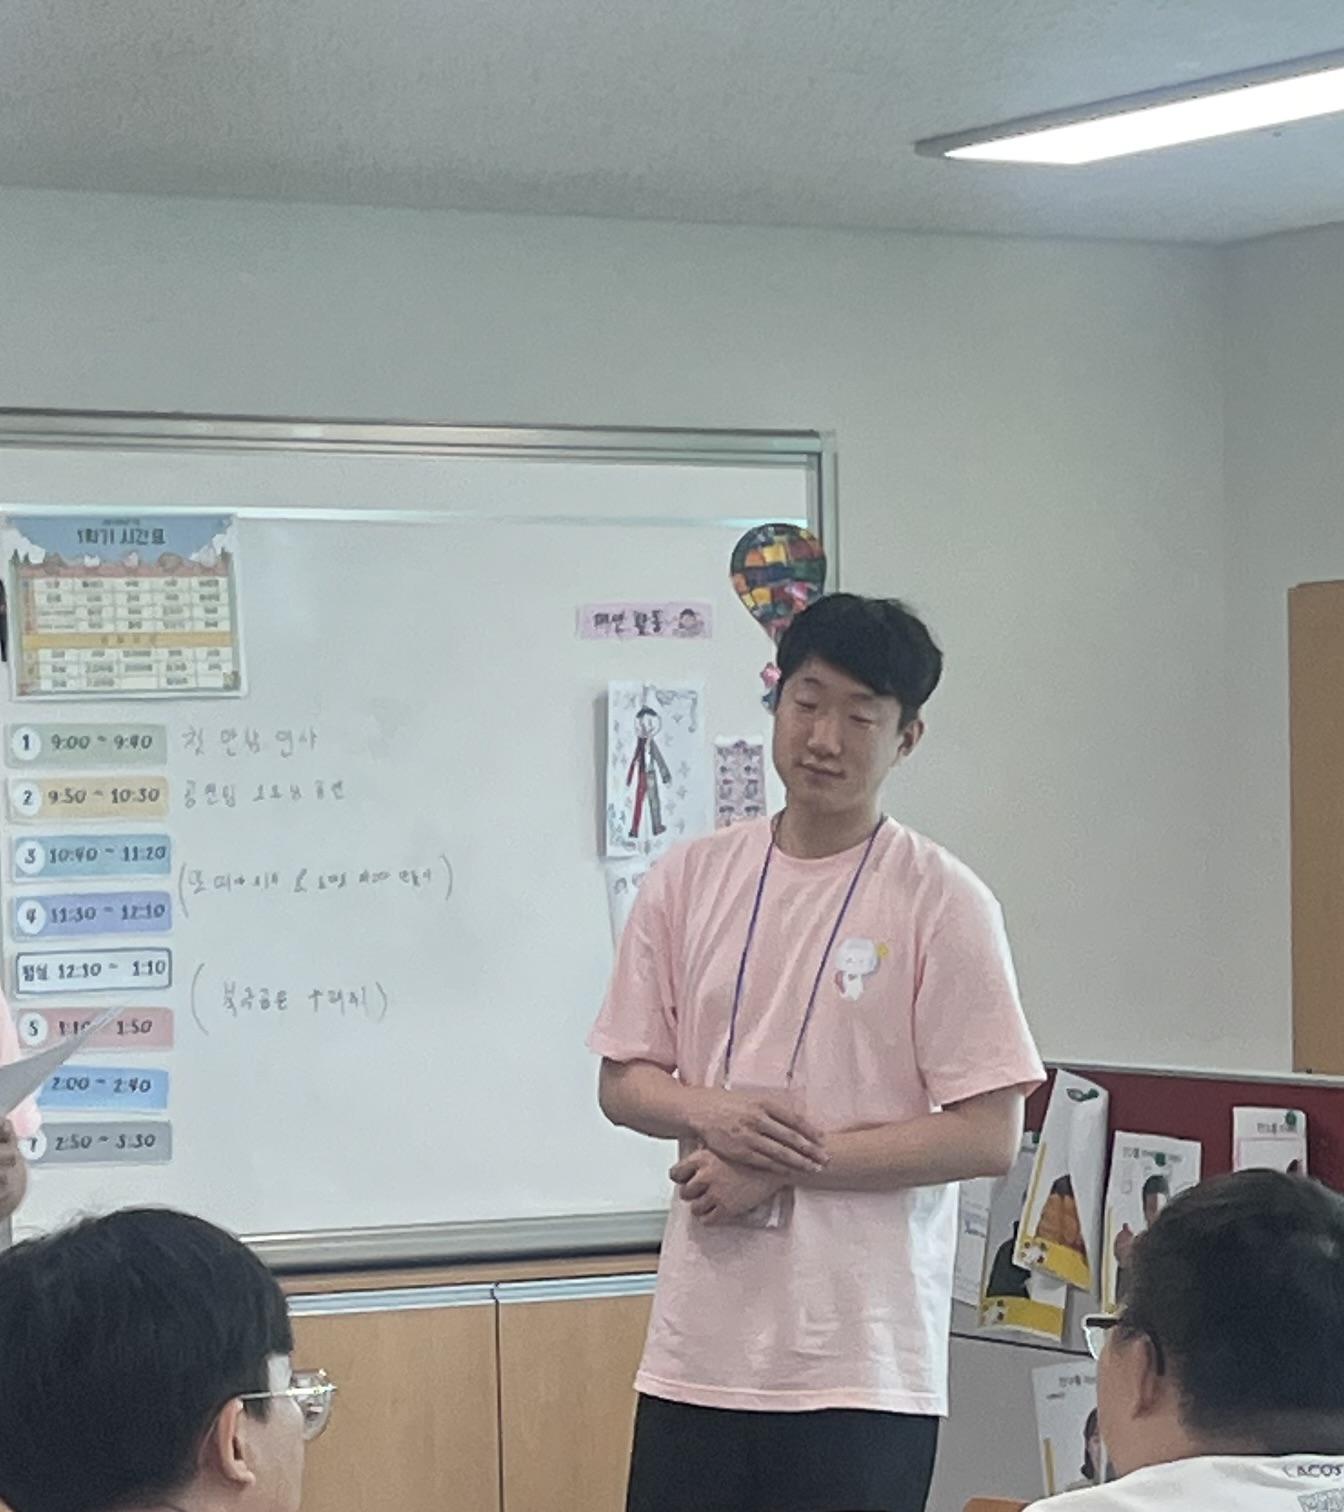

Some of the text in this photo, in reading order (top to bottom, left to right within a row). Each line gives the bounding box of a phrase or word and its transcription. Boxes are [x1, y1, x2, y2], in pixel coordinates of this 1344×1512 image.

[119, 528, 166, 545] 시간표
[51, 735, 91, 750] 9:00
[114, 735, 153, 750] 9:40
[123, 845, 167, 862] 11:20
[121, 903, 166, 921] 12:10
[58, 962, 102, 979] 12:10
[132, 959, 166, 977] 1:10
[116, 1018, 153, 1035] 1:50
[51, 1077, 90, 1091] 2:00
[113, 1077, 152, 1093] 2:40
[56, 1134, 93, 1151] 2:50
